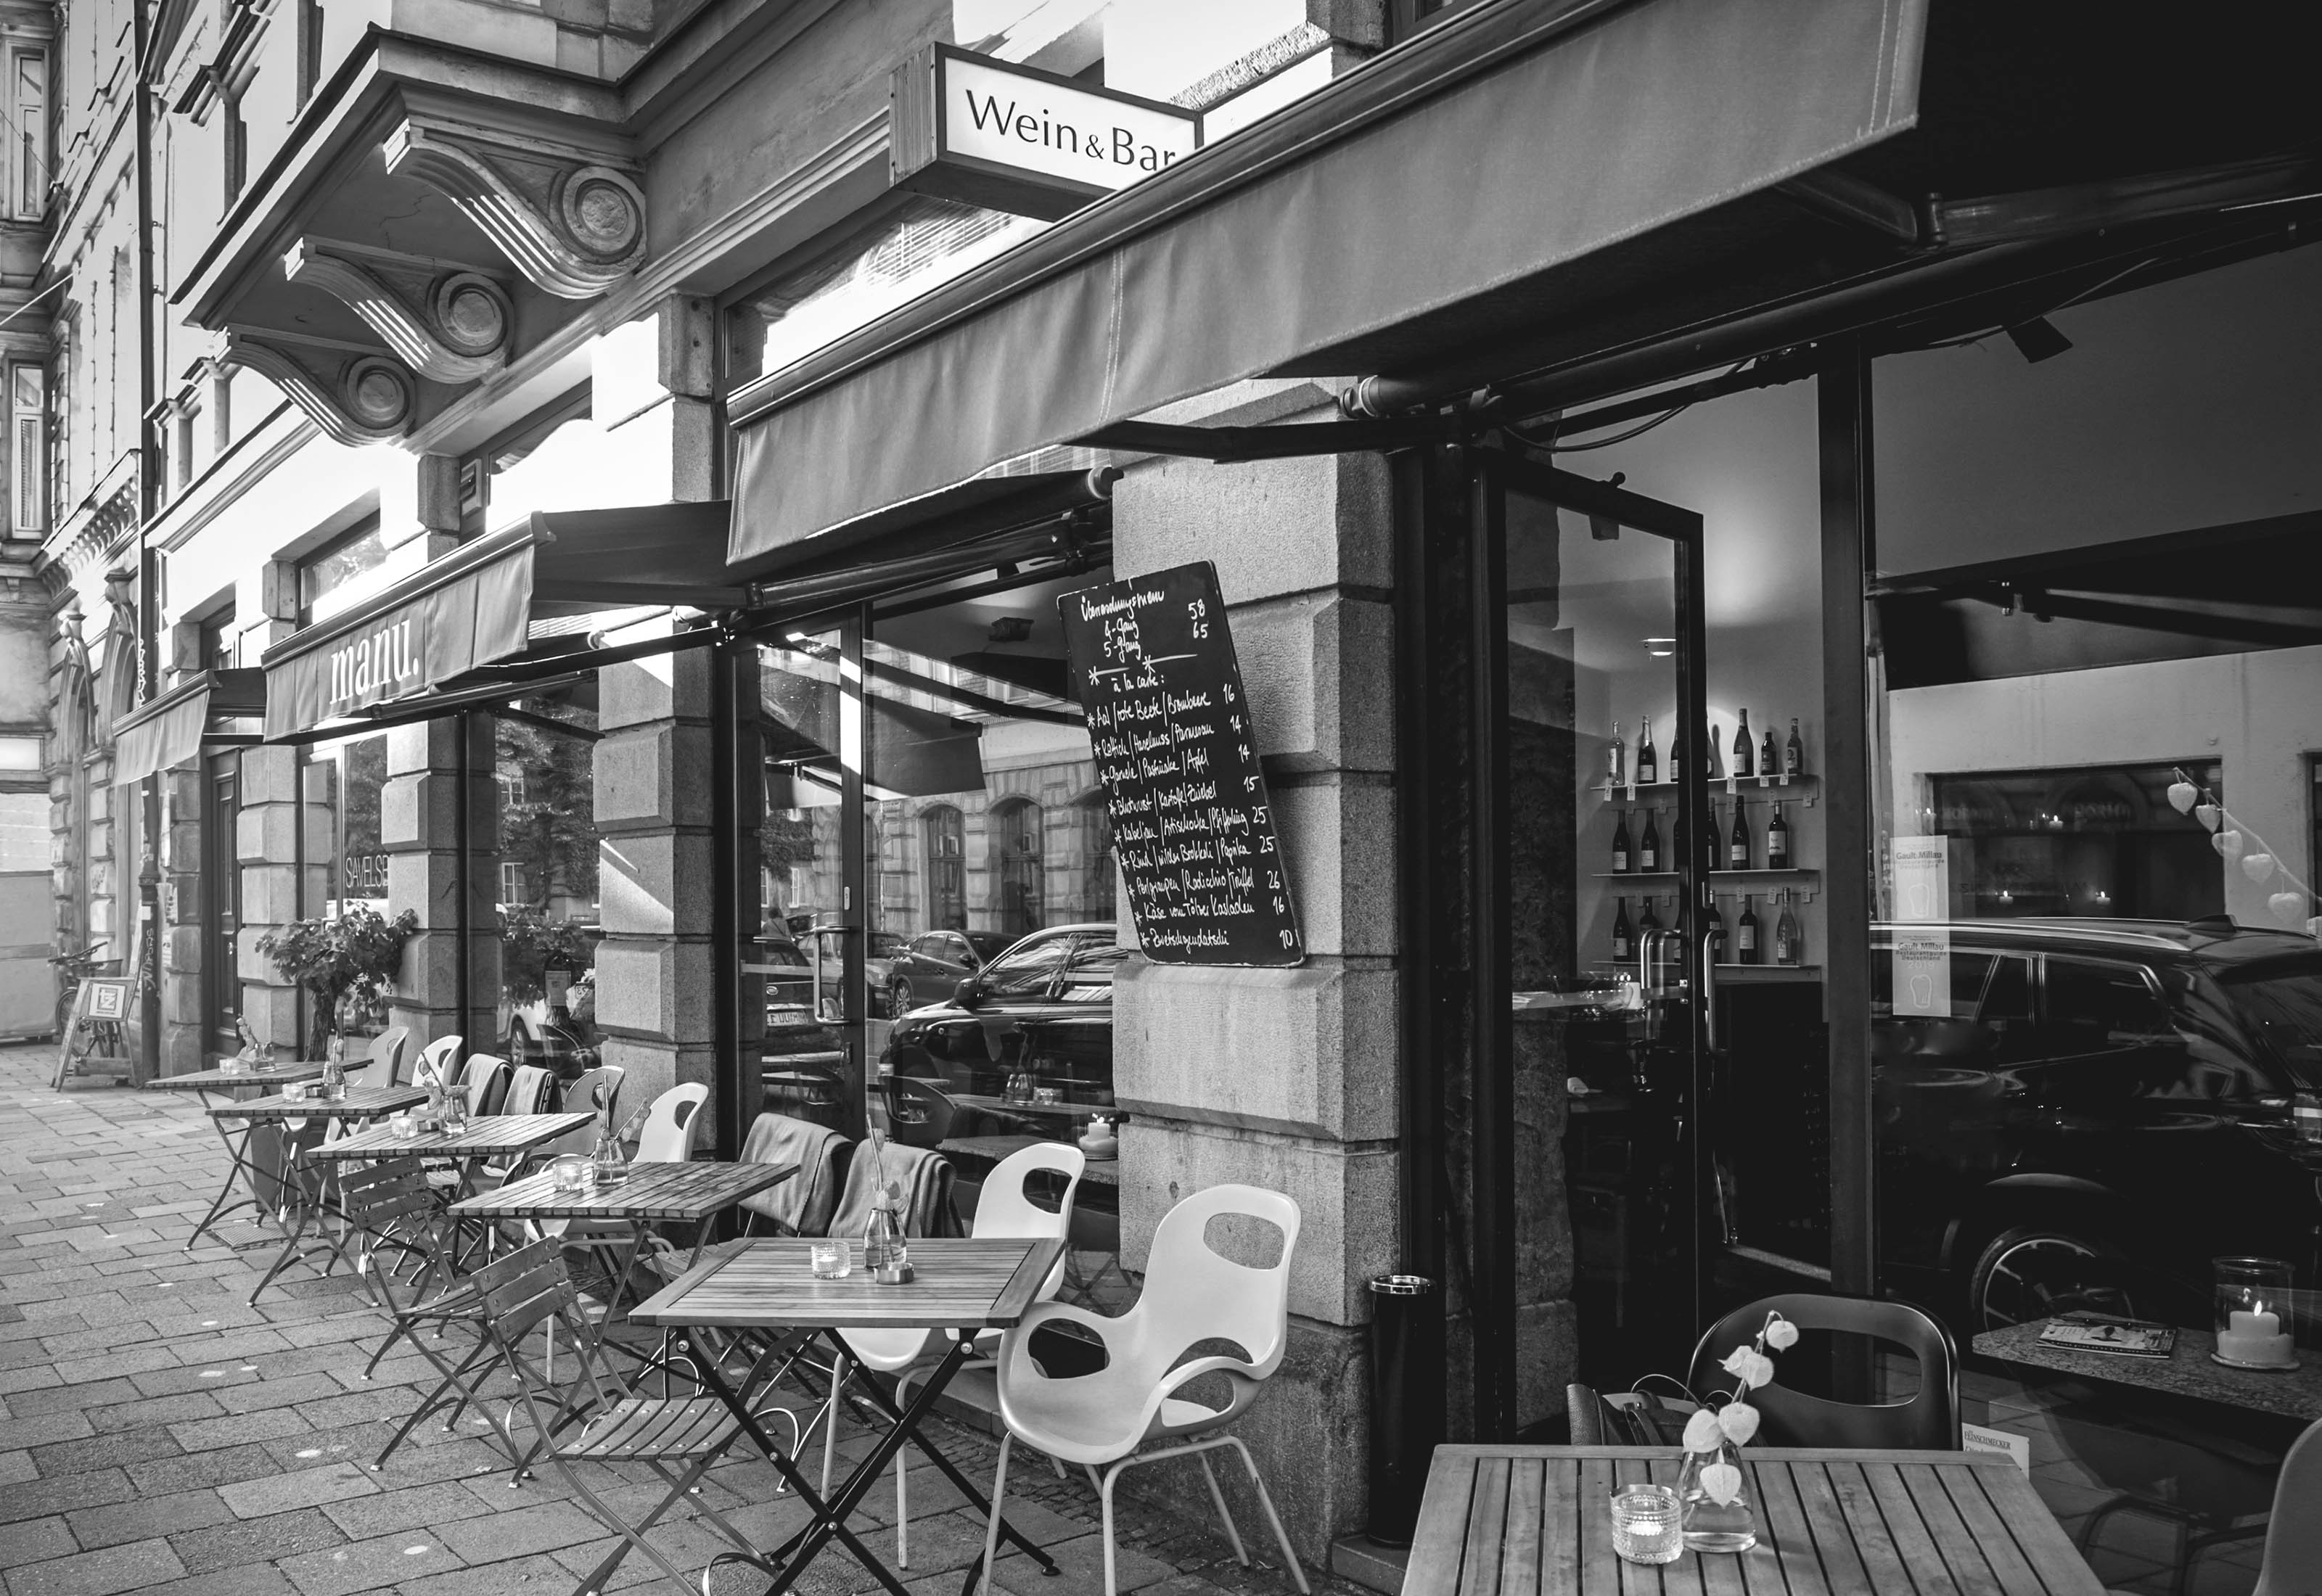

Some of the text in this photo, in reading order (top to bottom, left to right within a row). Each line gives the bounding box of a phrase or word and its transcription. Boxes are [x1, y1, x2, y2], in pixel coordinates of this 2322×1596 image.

[965, 89, 1078, 153] Wein
[1188, 598, 1205, 620] 58
[1193, 621, 1208, 638] 65
[1223, 683, 1235, 704] 16
[1230, 715, 1242, 734] 14
[1239, 744, 1250, 763] 14
[1244, 776, 1260, 793] 15
[1252, 806, 1268, 824] 25
[1259, 835, 1275, 854] 25
[1267, 870, 1281, 889] 26
[1273, 896, 1285, 916] 16
[1279, 929, 1293, 950] 10
